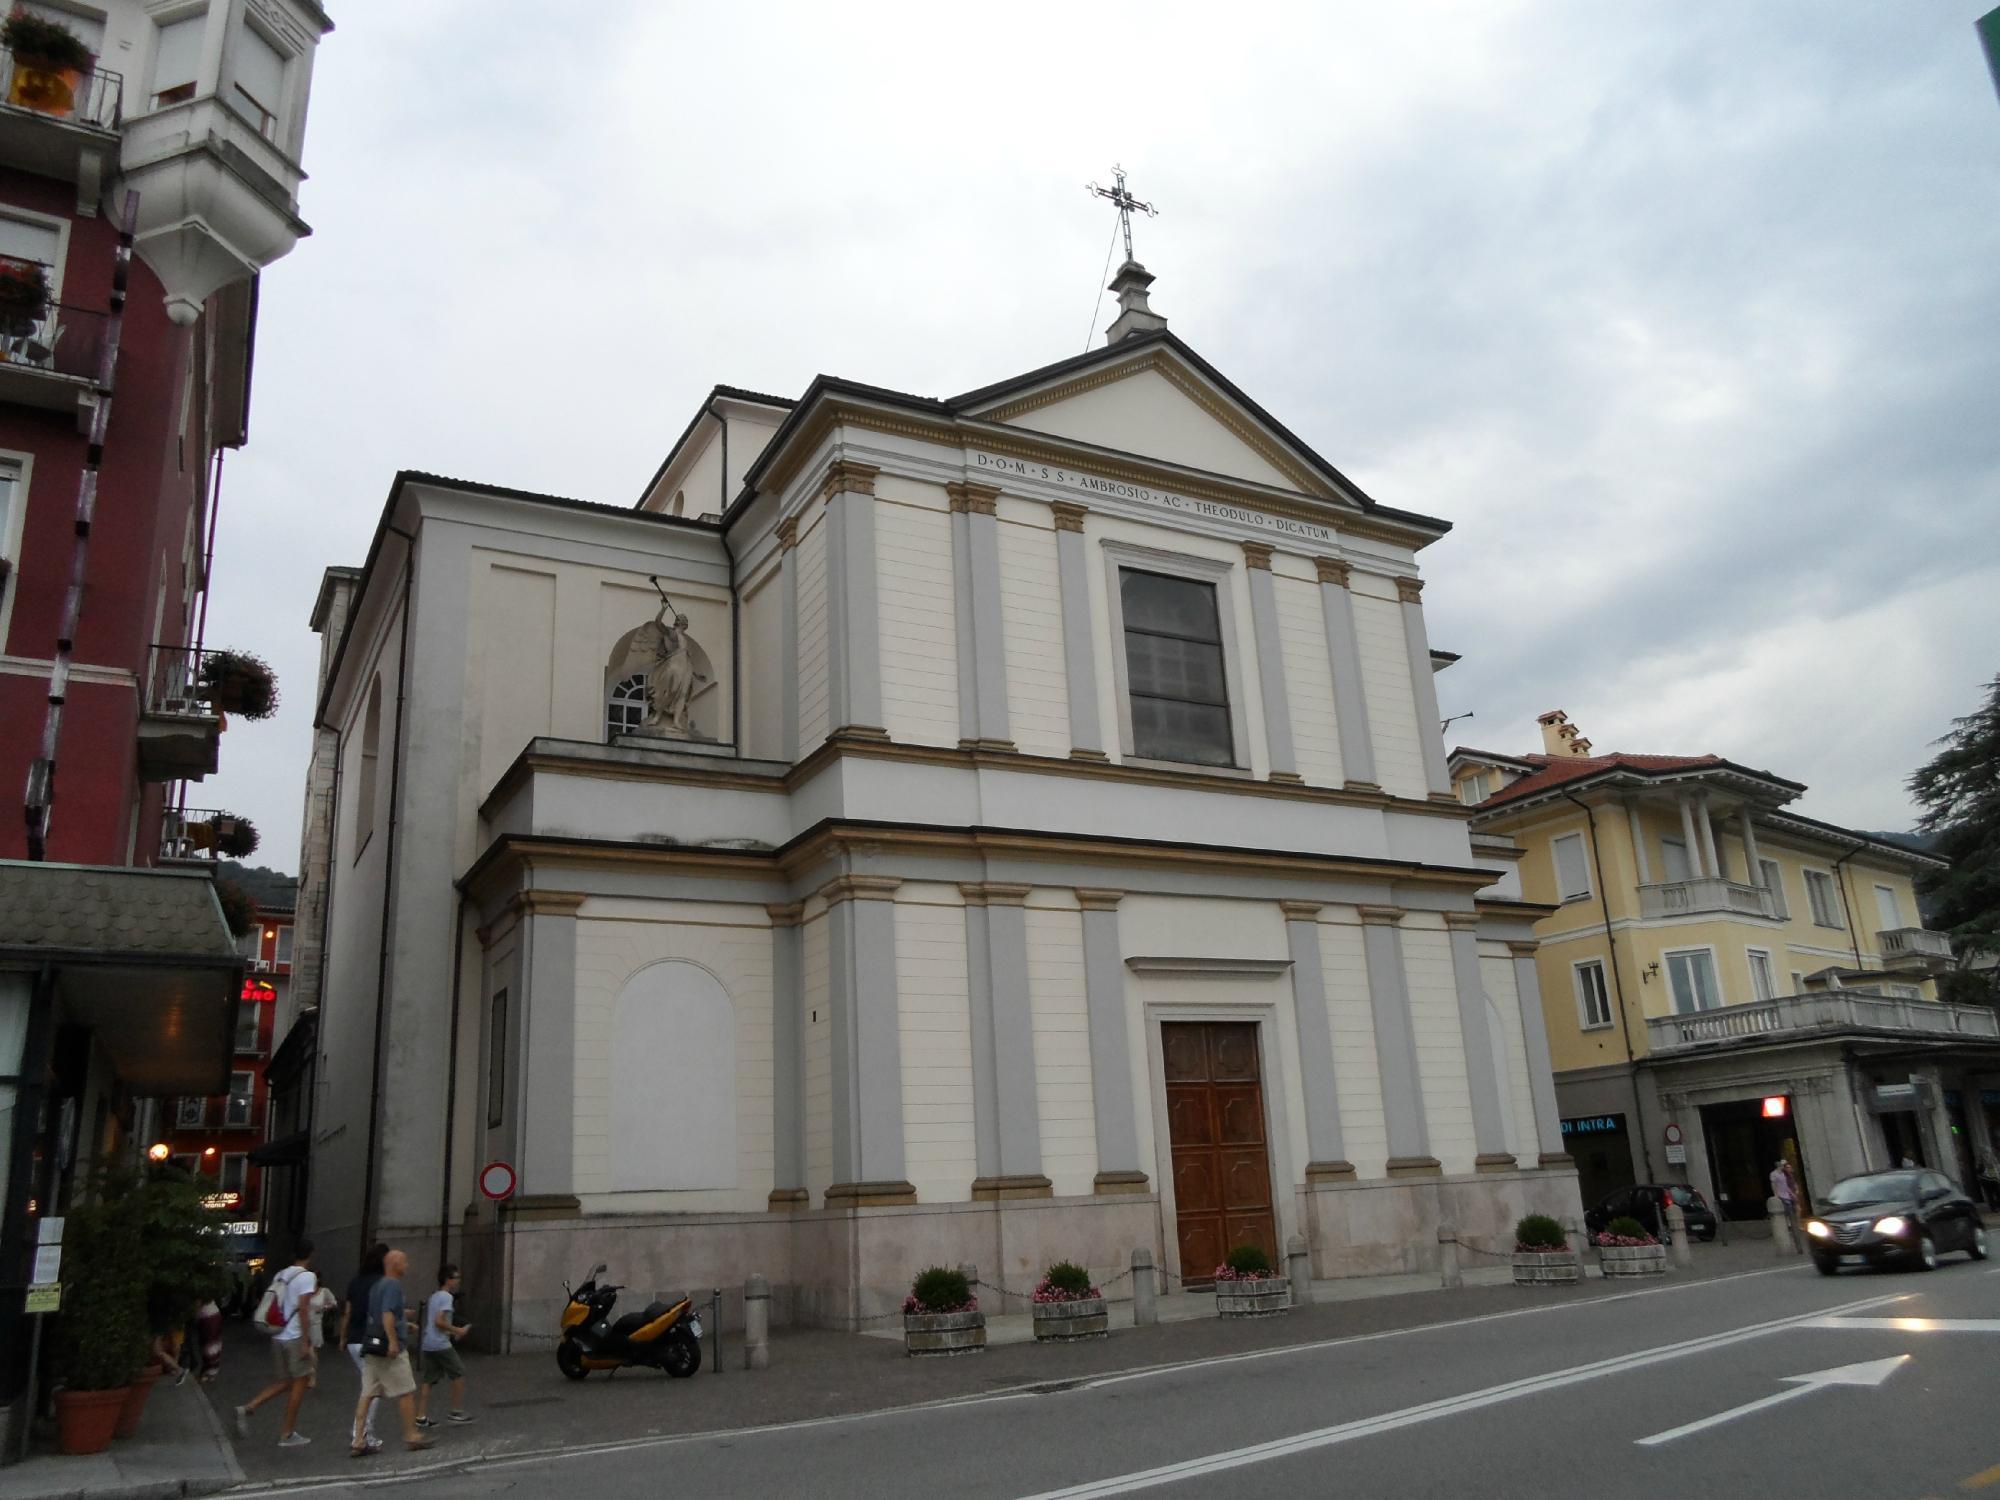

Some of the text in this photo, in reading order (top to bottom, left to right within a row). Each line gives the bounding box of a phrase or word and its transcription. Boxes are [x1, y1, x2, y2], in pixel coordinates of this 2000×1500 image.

[1080, 477, 1150, 501] AMBROSIO
[1162, 495, 1181, 508] AC
[1194, 501, 1264, 525] THEODULO
[1276, 519, 1329, 540] DICATUM
[1577, 1118, 1616, 1131] INTRA
